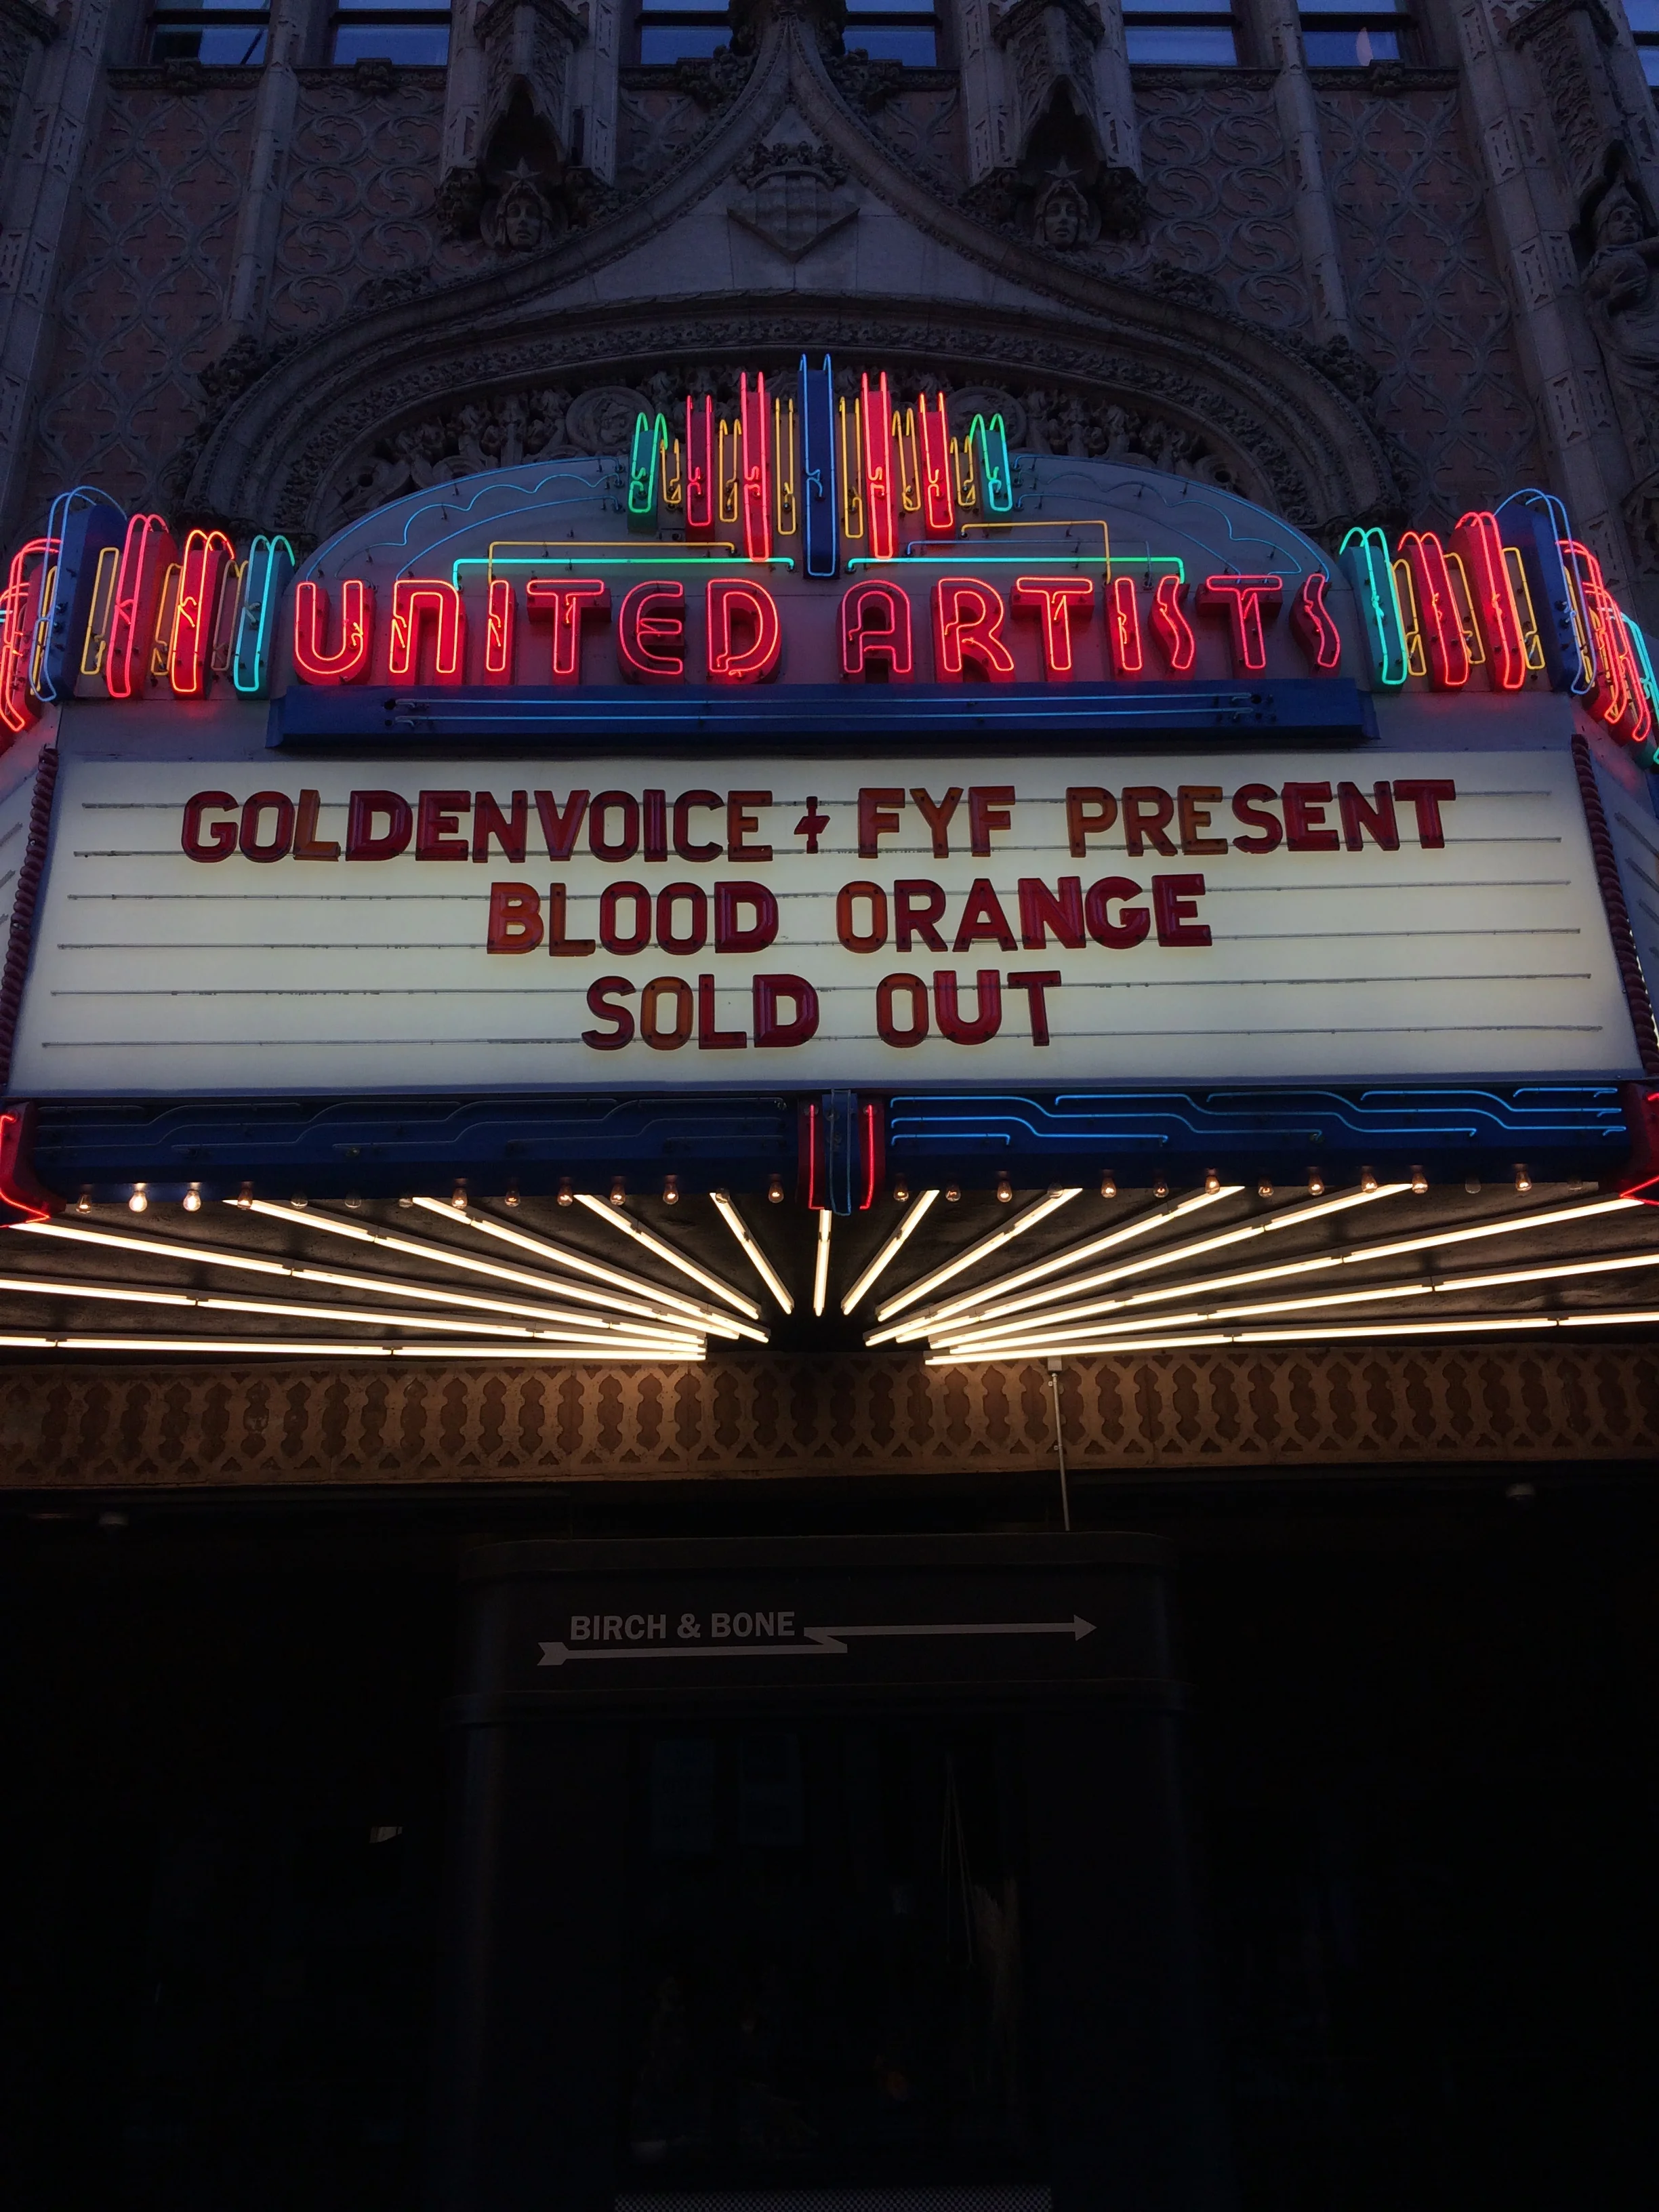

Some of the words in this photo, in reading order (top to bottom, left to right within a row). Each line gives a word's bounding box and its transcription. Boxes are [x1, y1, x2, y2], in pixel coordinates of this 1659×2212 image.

[291, 577, 782, 686] UNITED
[838, 573, 1340, 684] ARTISTS
[181, 789, 773, 863] GOLDENVOICE
[857, 785, 1016, 859] FYF
[1066, 779, 1456, 857] PRESENT
[487, 880, 779, 956] BLOOD
[836, 873, 1212, 954] ORANGE
[581, 973, 819, 1050] SOLD
[876, 969, 1062, 1048] OUT
[569, 1614, 668, 1641] BIRCH
[676, 1614, 702, 1639] &
[711, 1611, 796, 1638] BONE
